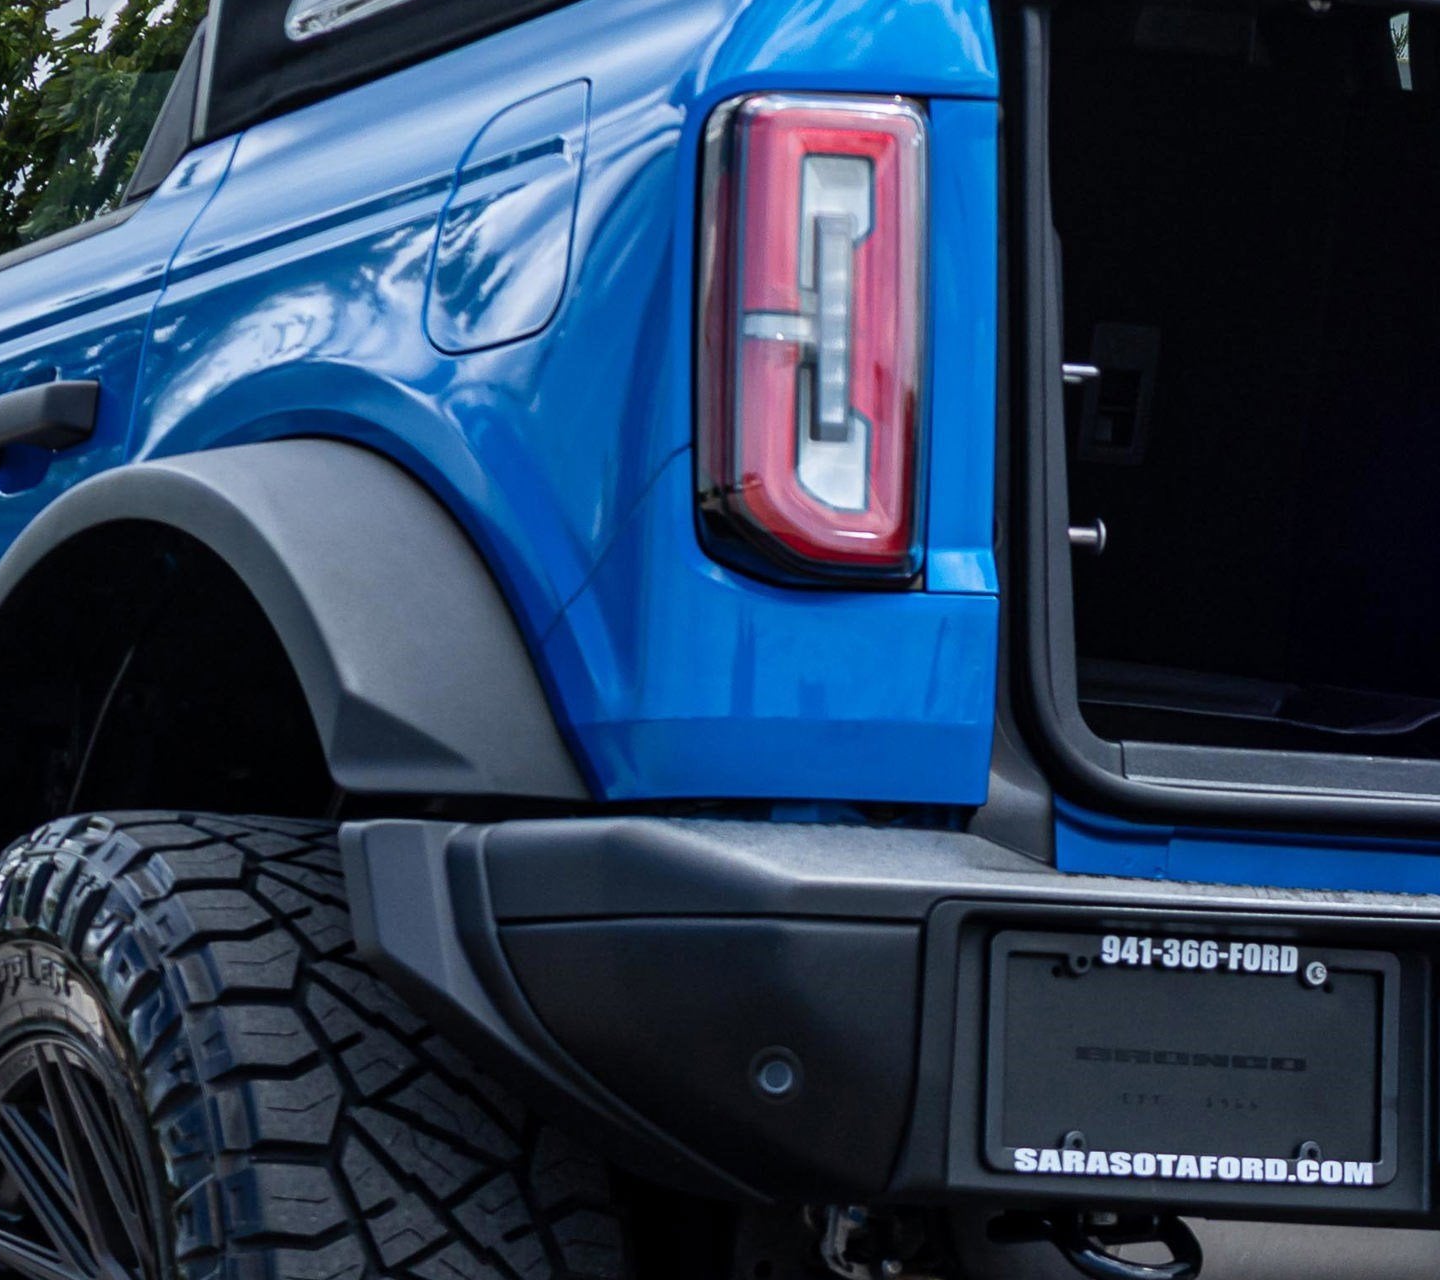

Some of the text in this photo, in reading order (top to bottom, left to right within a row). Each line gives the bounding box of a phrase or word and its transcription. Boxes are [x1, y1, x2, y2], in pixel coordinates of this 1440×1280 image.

[1101, 934, 1299, 973] 941-366-FORD
[1075, 1045, 1308, 1072] BRONCO
[1013, 1147, 1375, 1185] SARASOTAFORD.COM
